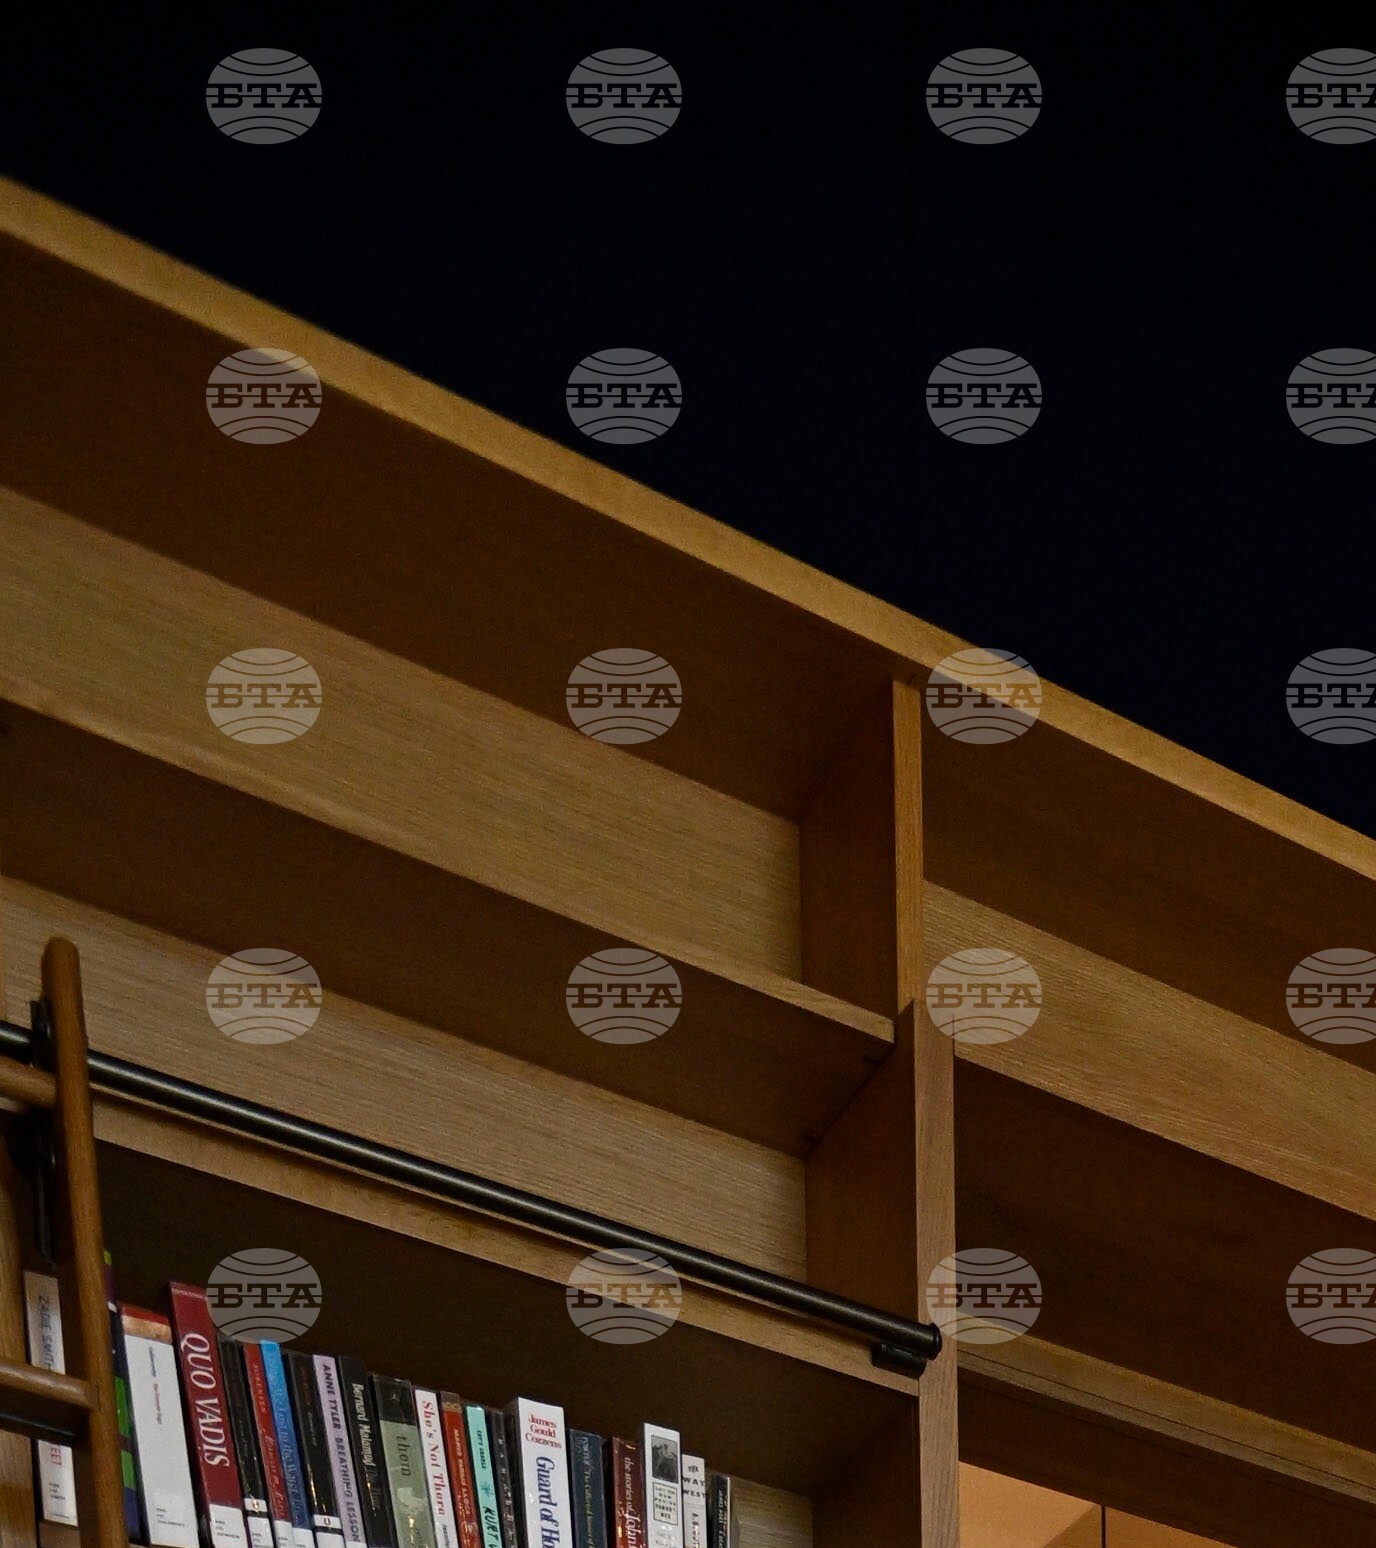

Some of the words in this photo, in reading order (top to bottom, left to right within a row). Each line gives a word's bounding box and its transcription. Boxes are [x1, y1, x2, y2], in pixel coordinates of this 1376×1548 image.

[180, 1333, 216, 1390] QUO
[322, 1364, 334, 1397] ANNE
[329, 1398, 341, 1430] TYLER
[196, 1398, 230, 1467] VADIS
[528, 1414, 557, 1428] James
[529, 1424, 556, 1438] Gould
[525, 1433, 562, 1449] Cozzens
[535, 1456, 558, 1507] Guard
[683, 1477, 705, 1487] WAY
[683, 1489, 706, 1498] WEST
[483, 1506, 499, 1541] KURT
